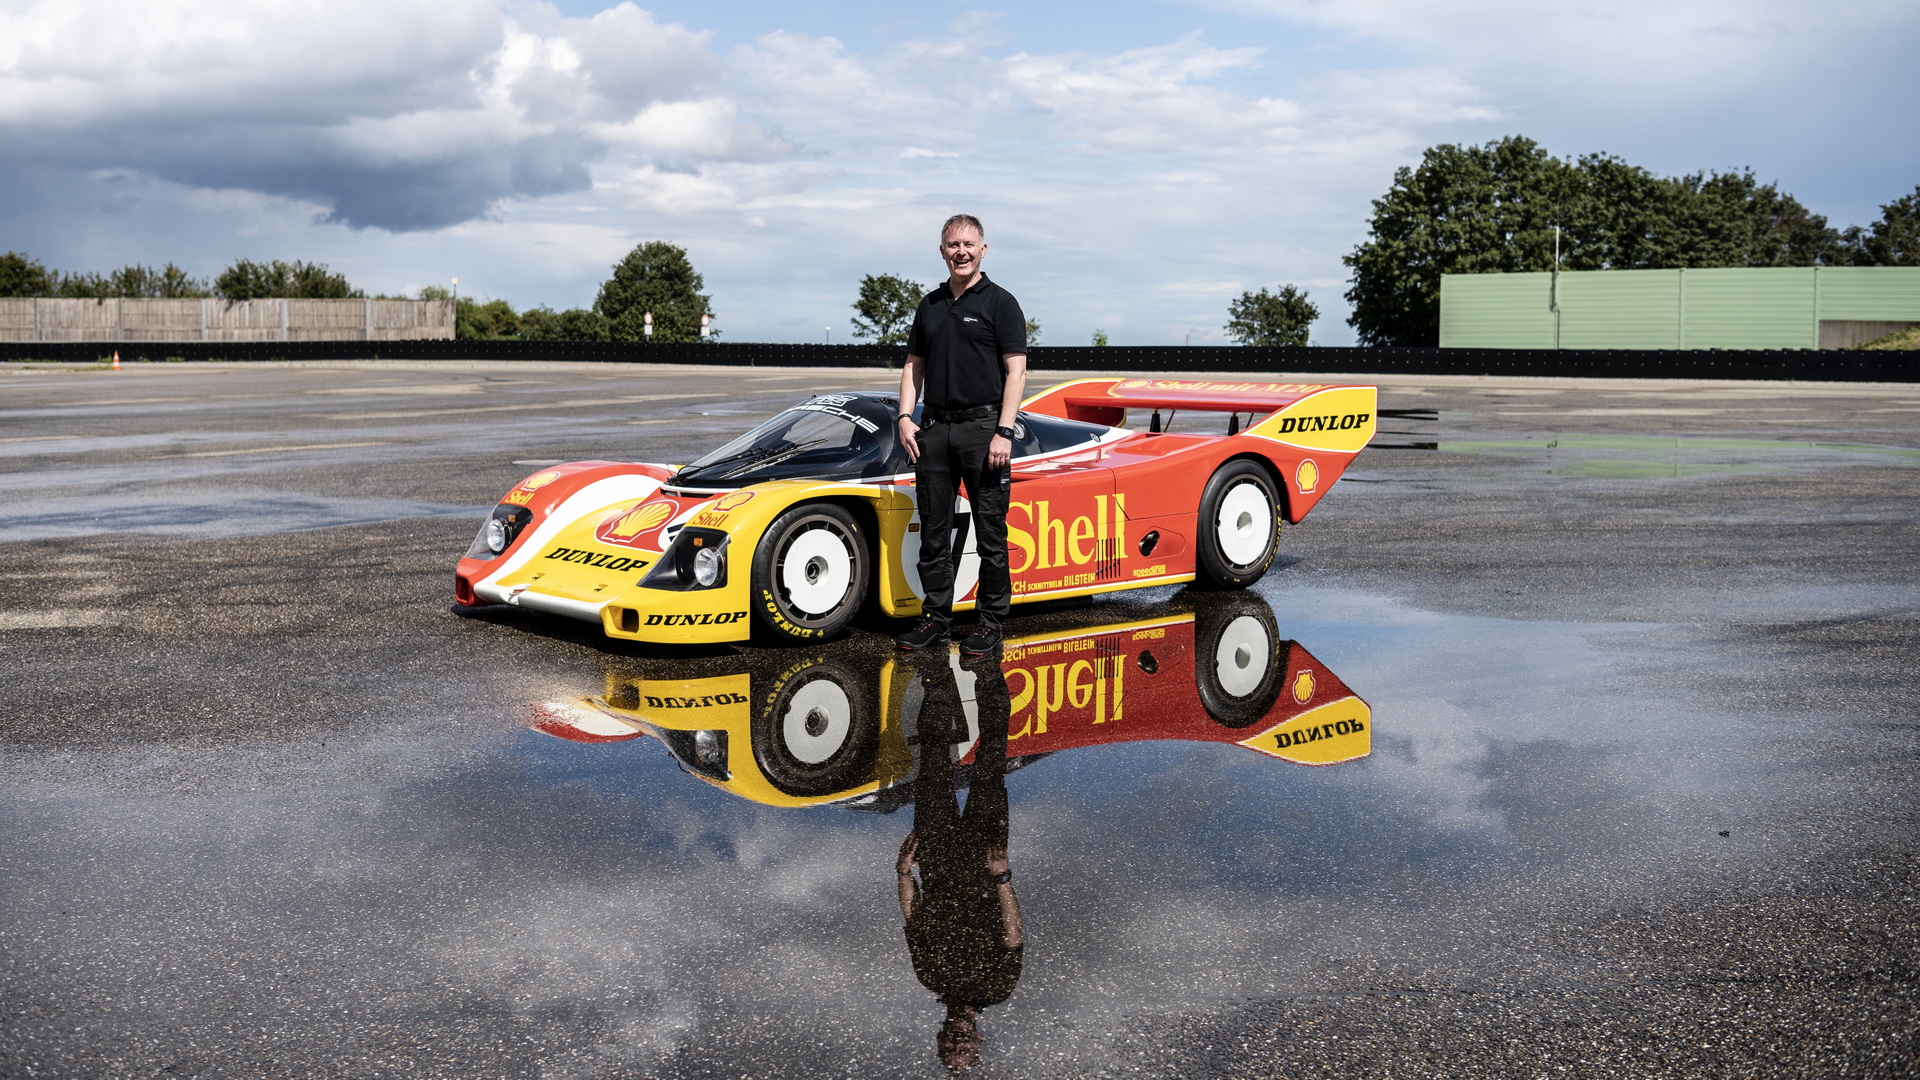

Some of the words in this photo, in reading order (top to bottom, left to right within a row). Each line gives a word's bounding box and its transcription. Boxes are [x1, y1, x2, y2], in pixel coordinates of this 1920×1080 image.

[1148, 380, 1212, 390] Shell
[1205, 382, 1257, 391] mit
[1278, 413, 1370, 434] DUNLOP
[504, 490, 535, 506] Shell
[692, 512, 730, 527] Shell
[1005, 492, 1128, 574] Shell
[544, 547, 650, 572] DUNLOP
[1063, 572, 1097, 587] BILSTEIN
[644, 611, 748, 626] DUNLOP
[762, 589, 813, 638] DUNLOP
